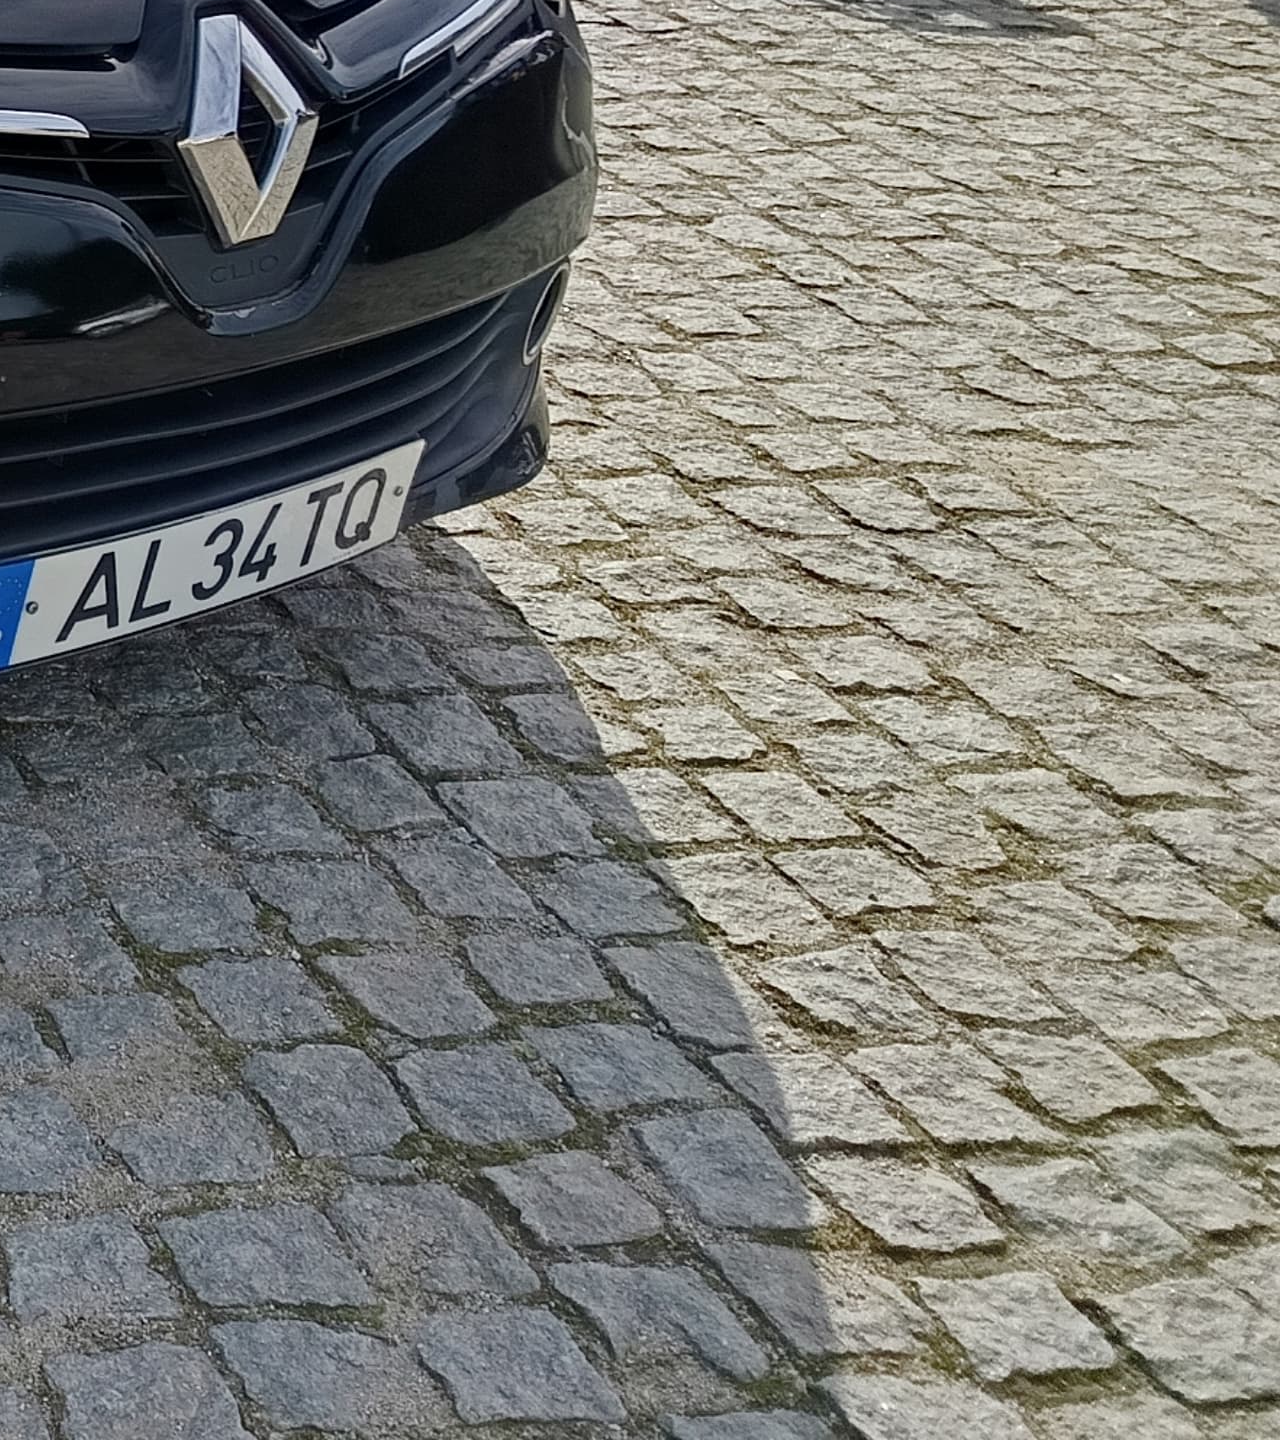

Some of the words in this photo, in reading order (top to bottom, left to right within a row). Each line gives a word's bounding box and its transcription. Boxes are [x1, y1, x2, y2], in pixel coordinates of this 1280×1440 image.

[210, 254, 279, 284] CLIO
[55, 539, 172, 643] AL
[191, 502, 282, 601] 34
[299, 467, 387, 568] TQ
